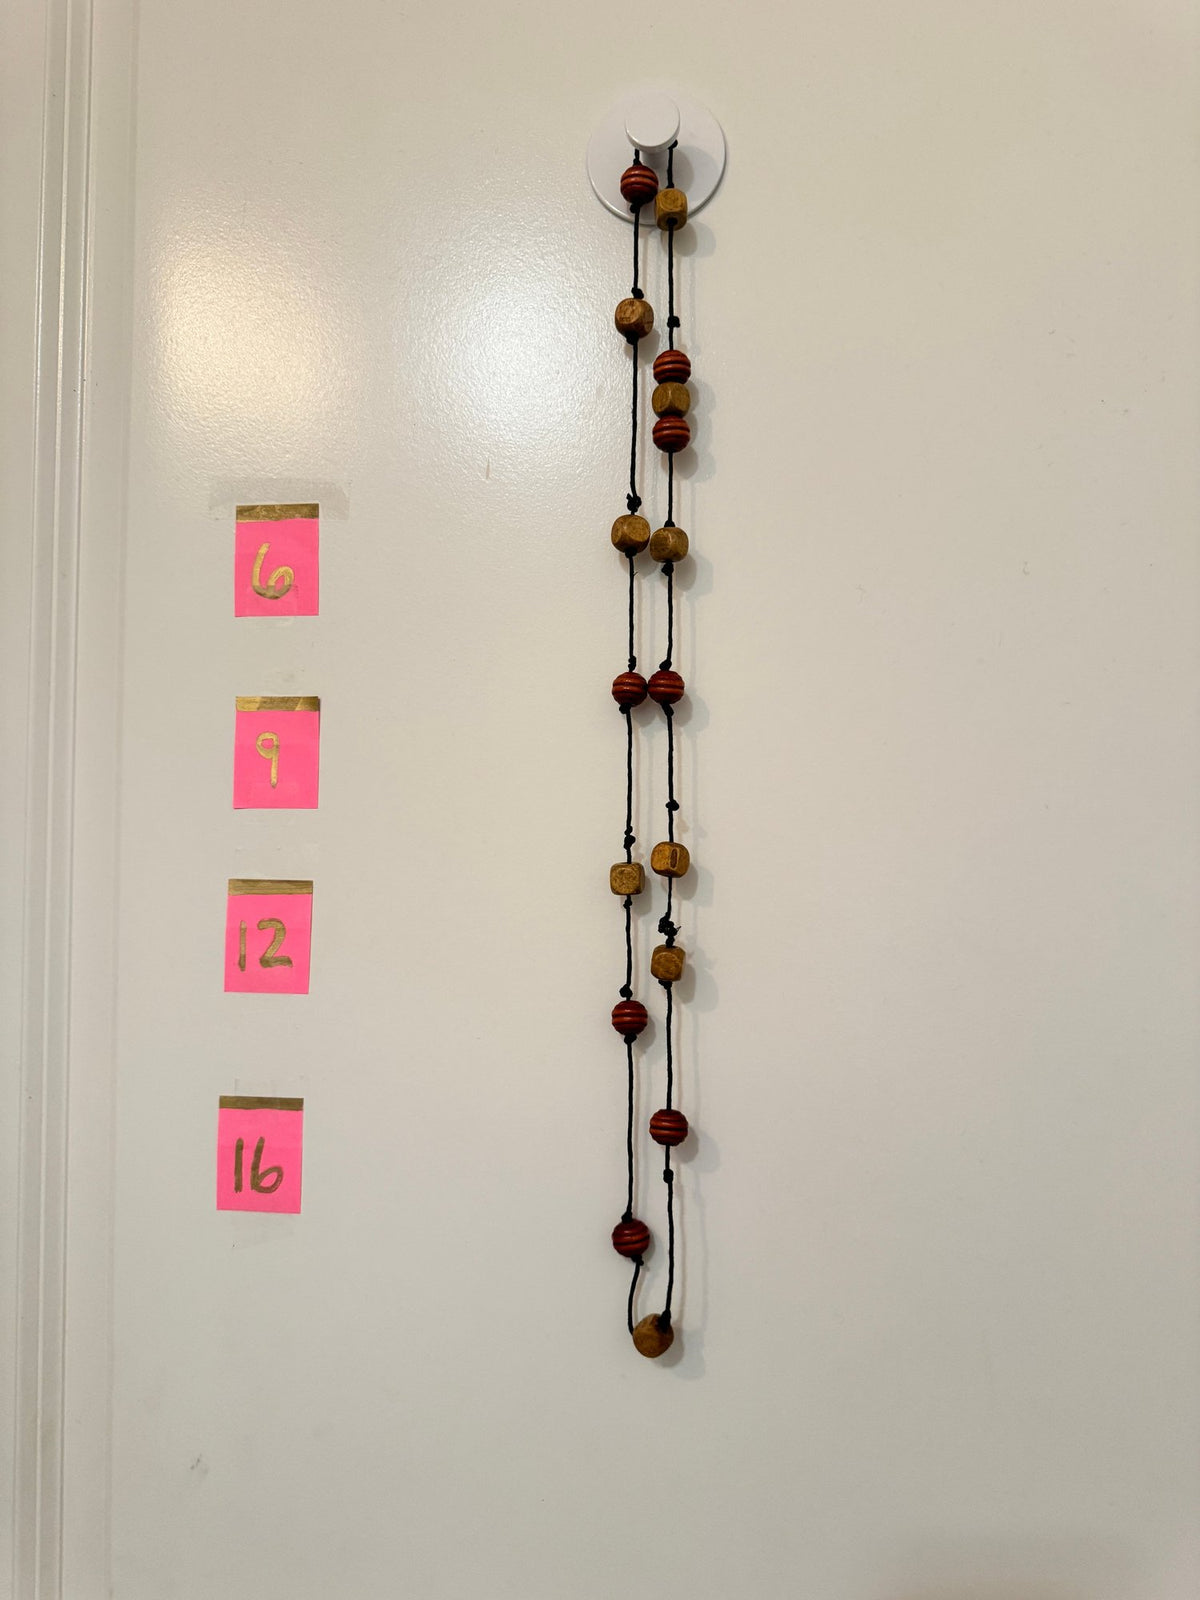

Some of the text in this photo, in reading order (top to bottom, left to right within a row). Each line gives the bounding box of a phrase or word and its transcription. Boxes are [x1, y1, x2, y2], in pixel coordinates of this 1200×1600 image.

[251, 542, 295, 600] 6
[255, 731, 280, 789] 9
[238, 917, 293, 972] 12
[234, 1136, 284, 1194] 16
